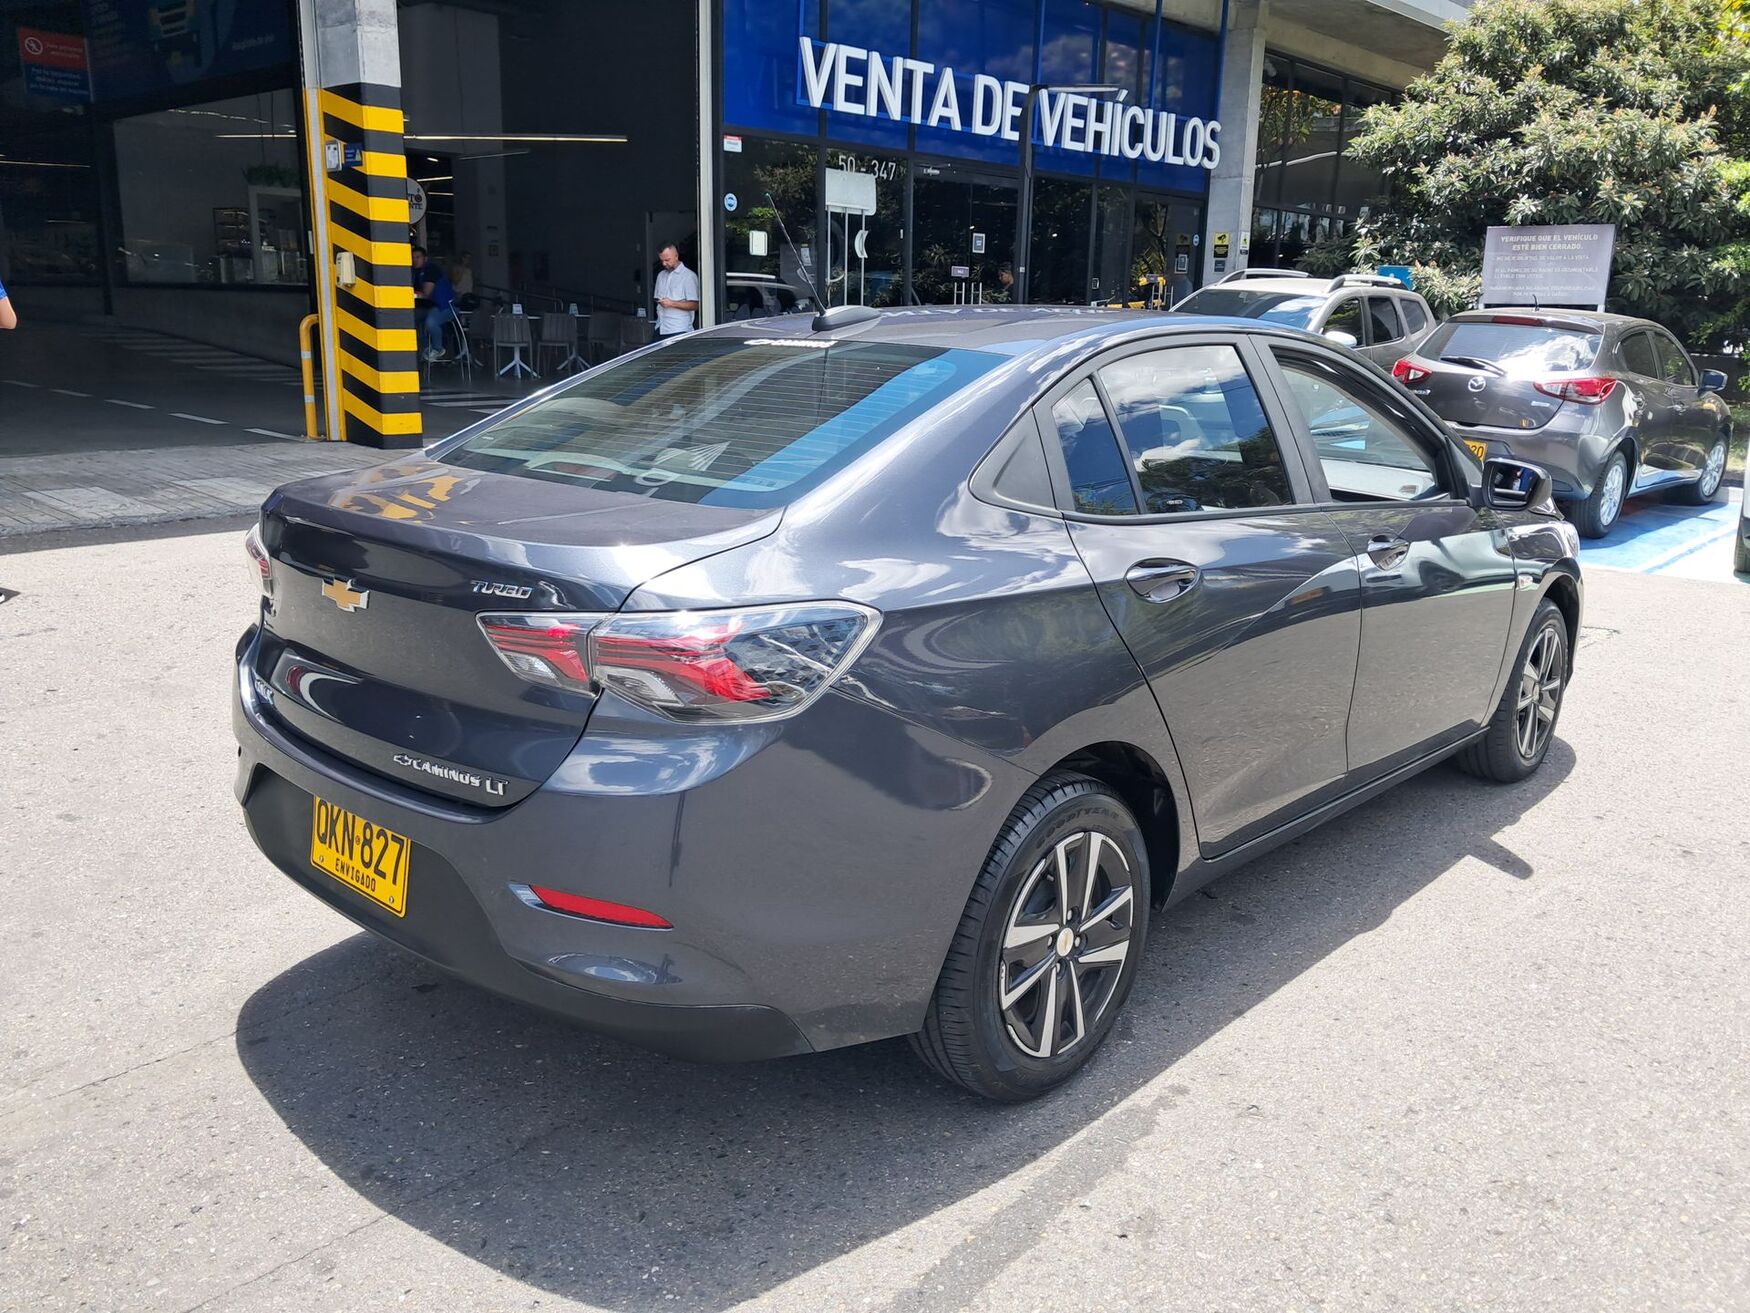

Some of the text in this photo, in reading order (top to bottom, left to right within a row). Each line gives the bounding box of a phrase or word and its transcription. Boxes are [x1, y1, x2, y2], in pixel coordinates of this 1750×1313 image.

[799, 36, 1222, 170] VENTA DE VEHÍCULOS
[871, 160, 897, 181] 347
[1501, 235, 1537, 243] VERIFIQUE
[1563, 233, 1599, 241] VEHÍCULO
[470, 579, 534, 599] TURBO
[411, 759, 509, 796] CAMINOS LT
[360, 821, 405, 886] 827
[335, 858, 377, 892] ENVIGADO
